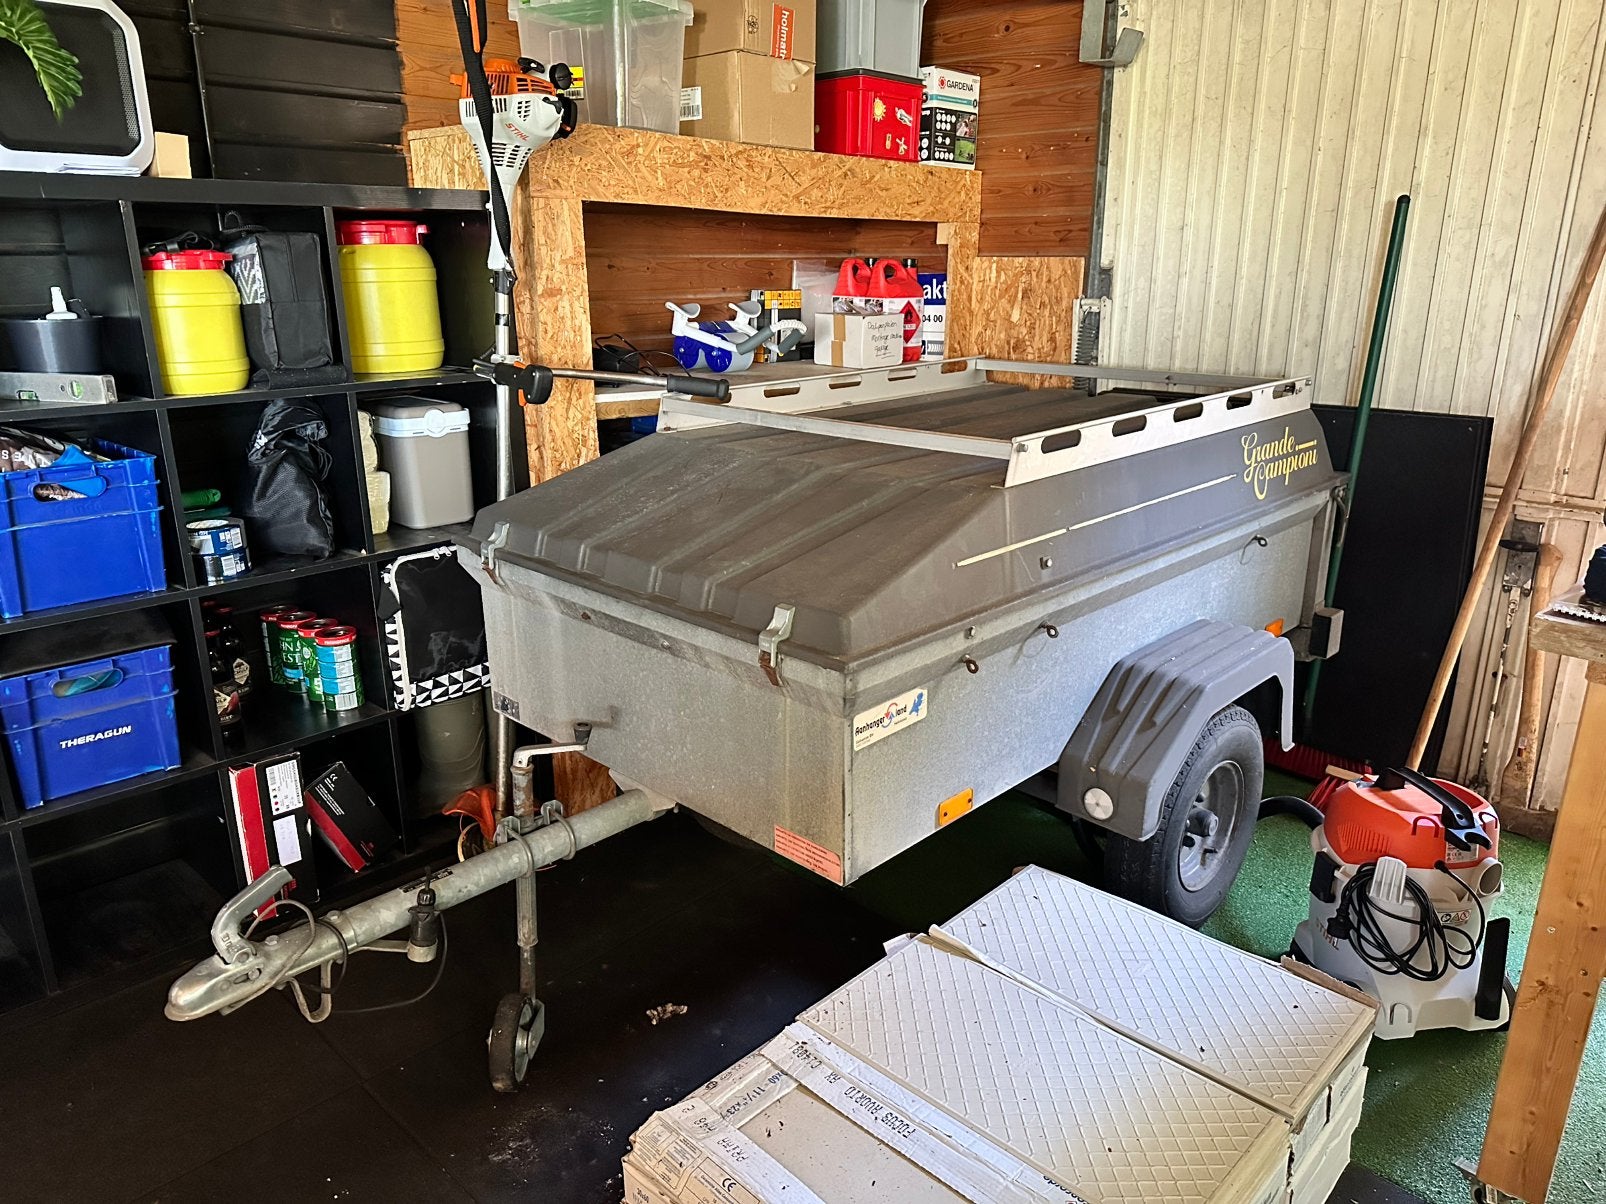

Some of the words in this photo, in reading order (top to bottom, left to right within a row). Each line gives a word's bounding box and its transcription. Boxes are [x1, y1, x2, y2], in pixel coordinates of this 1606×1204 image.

[779, 9, 789, 60] holmatr
[946, 79, 974, 92] GARDENA
[505, 122, 530, 141] STIHL
[933, 314, 943, 323] 00
[1241, 426, 1297, 483] Grande
[1253, 448, 1318, 500] Campioni
[895, 704, 908, 718] land
[59, 724, 132, 749] THERAGUN
[824, 1070, 842, 1085] AX
[843, 1084, 884, 1116] AVORIO
[879, 1108, 917, 1140] FOCUS
[722, 1177, 737, 1192] CE
